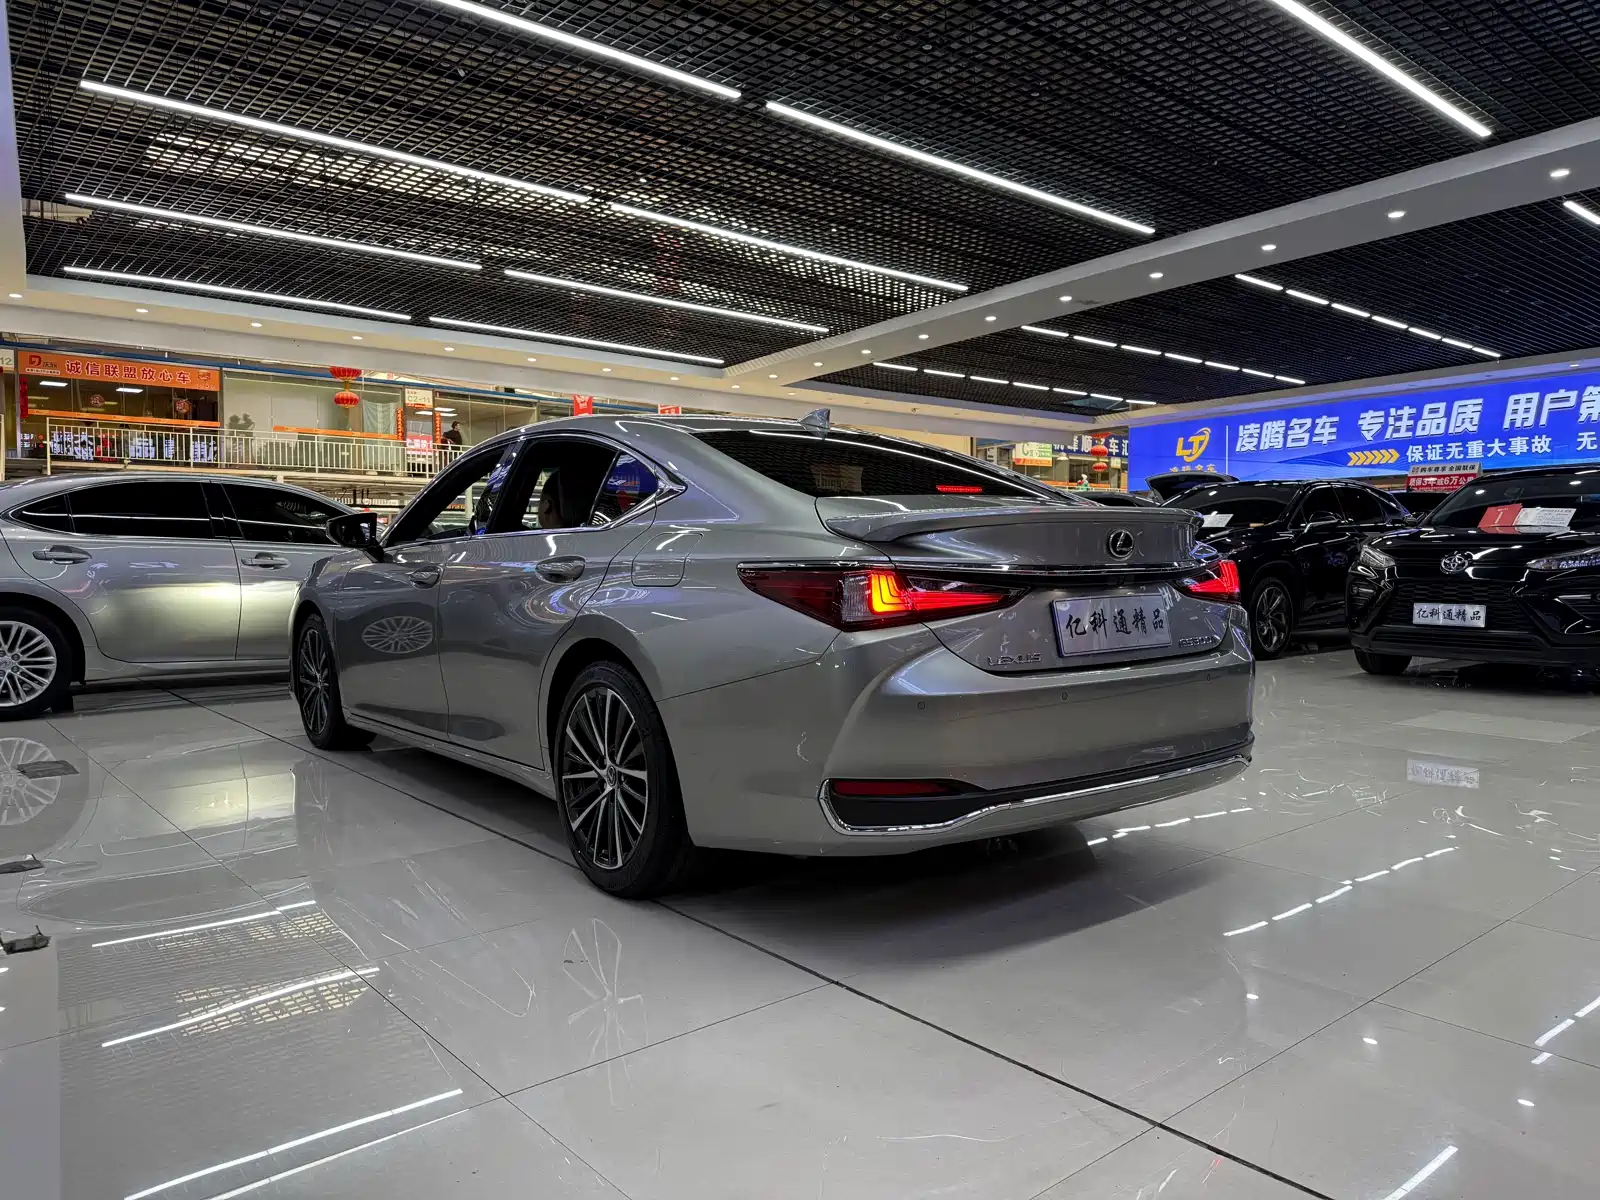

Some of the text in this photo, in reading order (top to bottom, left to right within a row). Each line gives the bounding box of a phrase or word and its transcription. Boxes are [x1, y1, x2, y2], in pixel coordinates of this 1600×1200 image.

[65, 359, 192, 384] 诚信联盟放心车
[407, 395, 431, 404] C2-11
[1235, 414, 1340, 454] 凌腾名车
[1357, 397, 1485, 442] 专注品质
[1406, 431, 1598, 463] 保证无重大事故 无
[1065, 606, 1165, 639] 亿科通精品
[1416, 606, 1482, 622] 亿科通精品
[986, 652, 1042, 666] LEXUS
